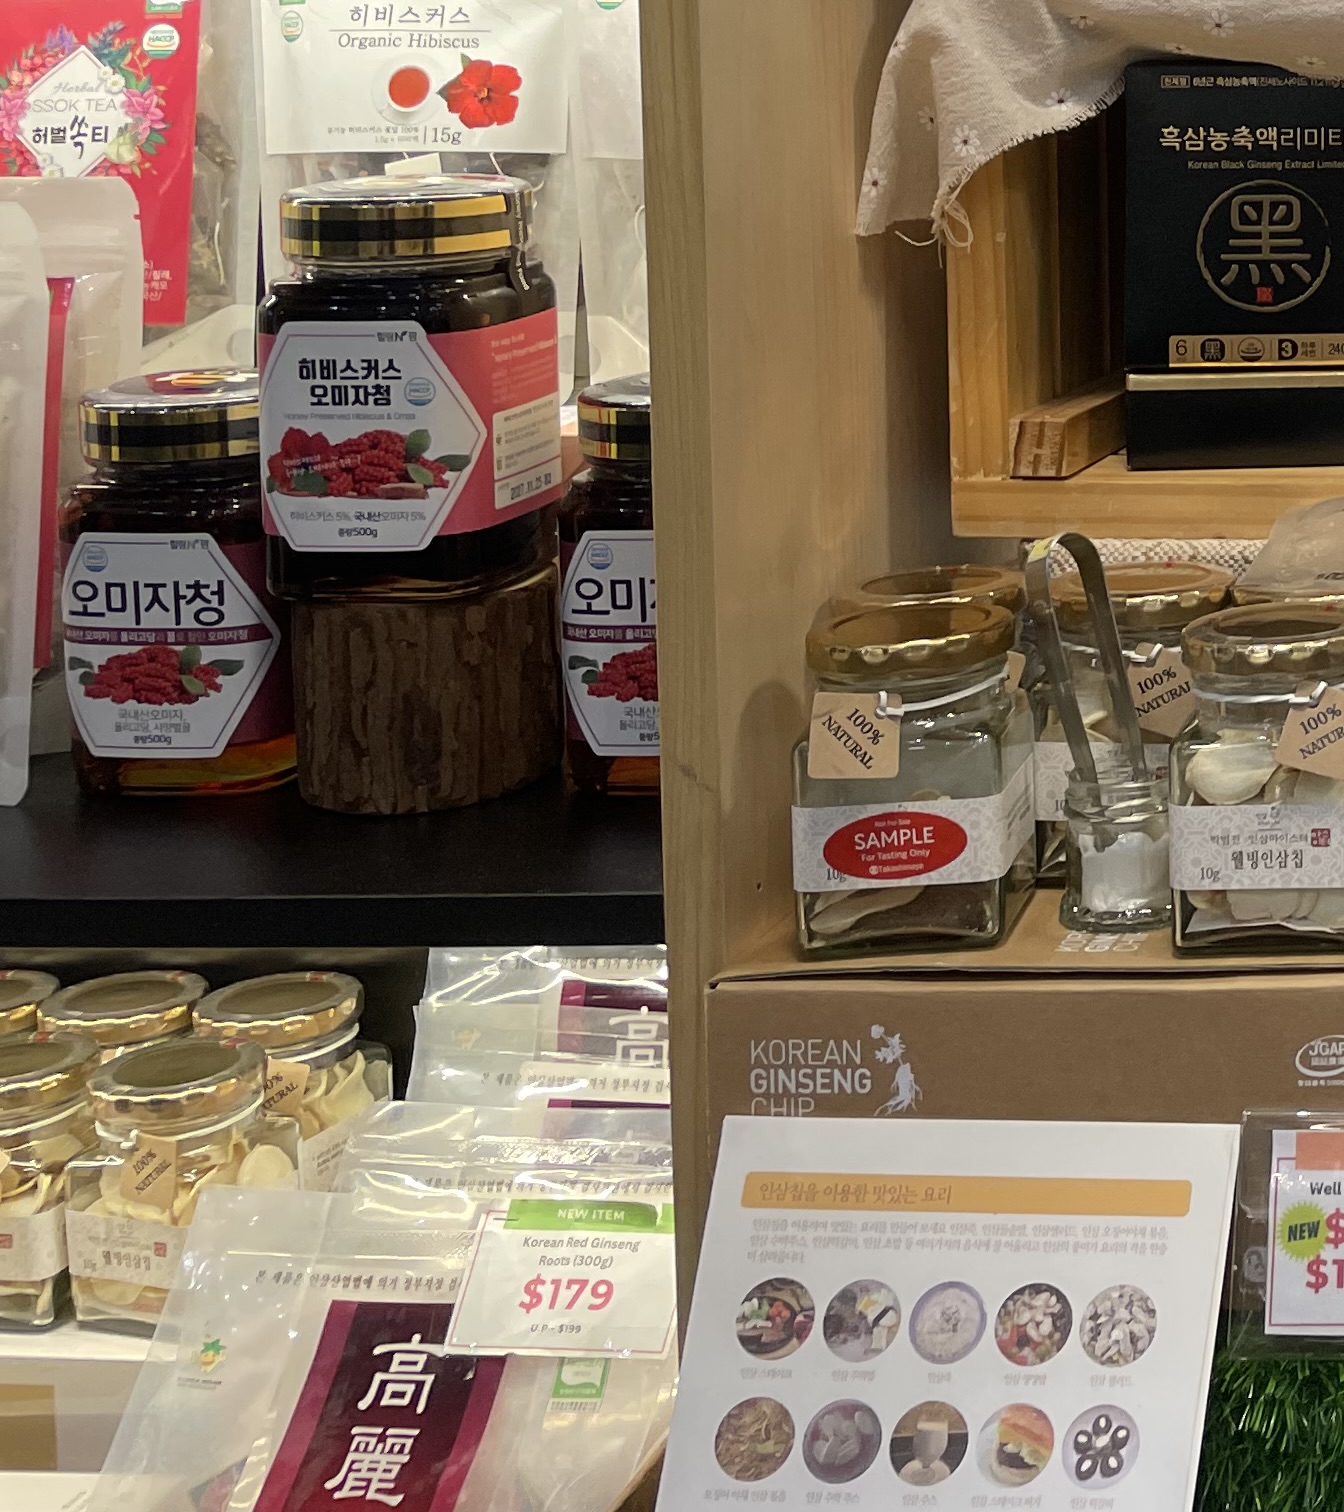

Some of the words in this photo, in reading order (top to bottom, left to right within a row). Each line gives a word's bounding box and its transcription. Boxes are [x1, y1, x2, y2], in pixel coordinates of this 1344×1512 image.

[350, 4, 471, 28] 히비스커스
[338, 32, 402, 50] Organic
[408, 33, 480, 49] Hibiscus
[32, 99, 79, 113] SSOK
[86, 99, 117, 111] TEA
[432, 128, 462, 145] 15g
[299, 358, 402, 380] 히비스커스
[310, 384, 391, 406] 오미자청
[68, 580, 225, 626] 오미자청
[845, 706, 885, 747] 100%
[1297, 703, 1343, 737] 100%
[820, 713, 874, 772] NATURAL
[854, 826, 935, 851] SAMPLE
[861, 853, 876, 862] For
[878, 850, 908, 860] Tasting
[909, 849, 930, 858] Only
[1231, 849, 1304, 869] 웰빙인삼칩
[750, 1038, 862, 1066] KOREAN
[749, 1067, 872, 1095] GINSENG
[750, 1097, 814, 1117] CHIP
[1310, 1182, 1342, 1195] Well
[557, 1208, 589, 1219] NEW
[592, 1209, 625, 1221] ITEM
[1287, 1219, 1321, 1243] NEW
[523, 1236, 565, 1248] Korean
[566, 1238, 587, 1248] Red
[591, 1238, 641, 1252] Ginseng
[538, 1255, 571, 1267] Roots
[573, 1256, 614, 1269] (300g)
[519, 1273, 614, 1314] $179
[325, 1333, 445, 1507] 高麗
